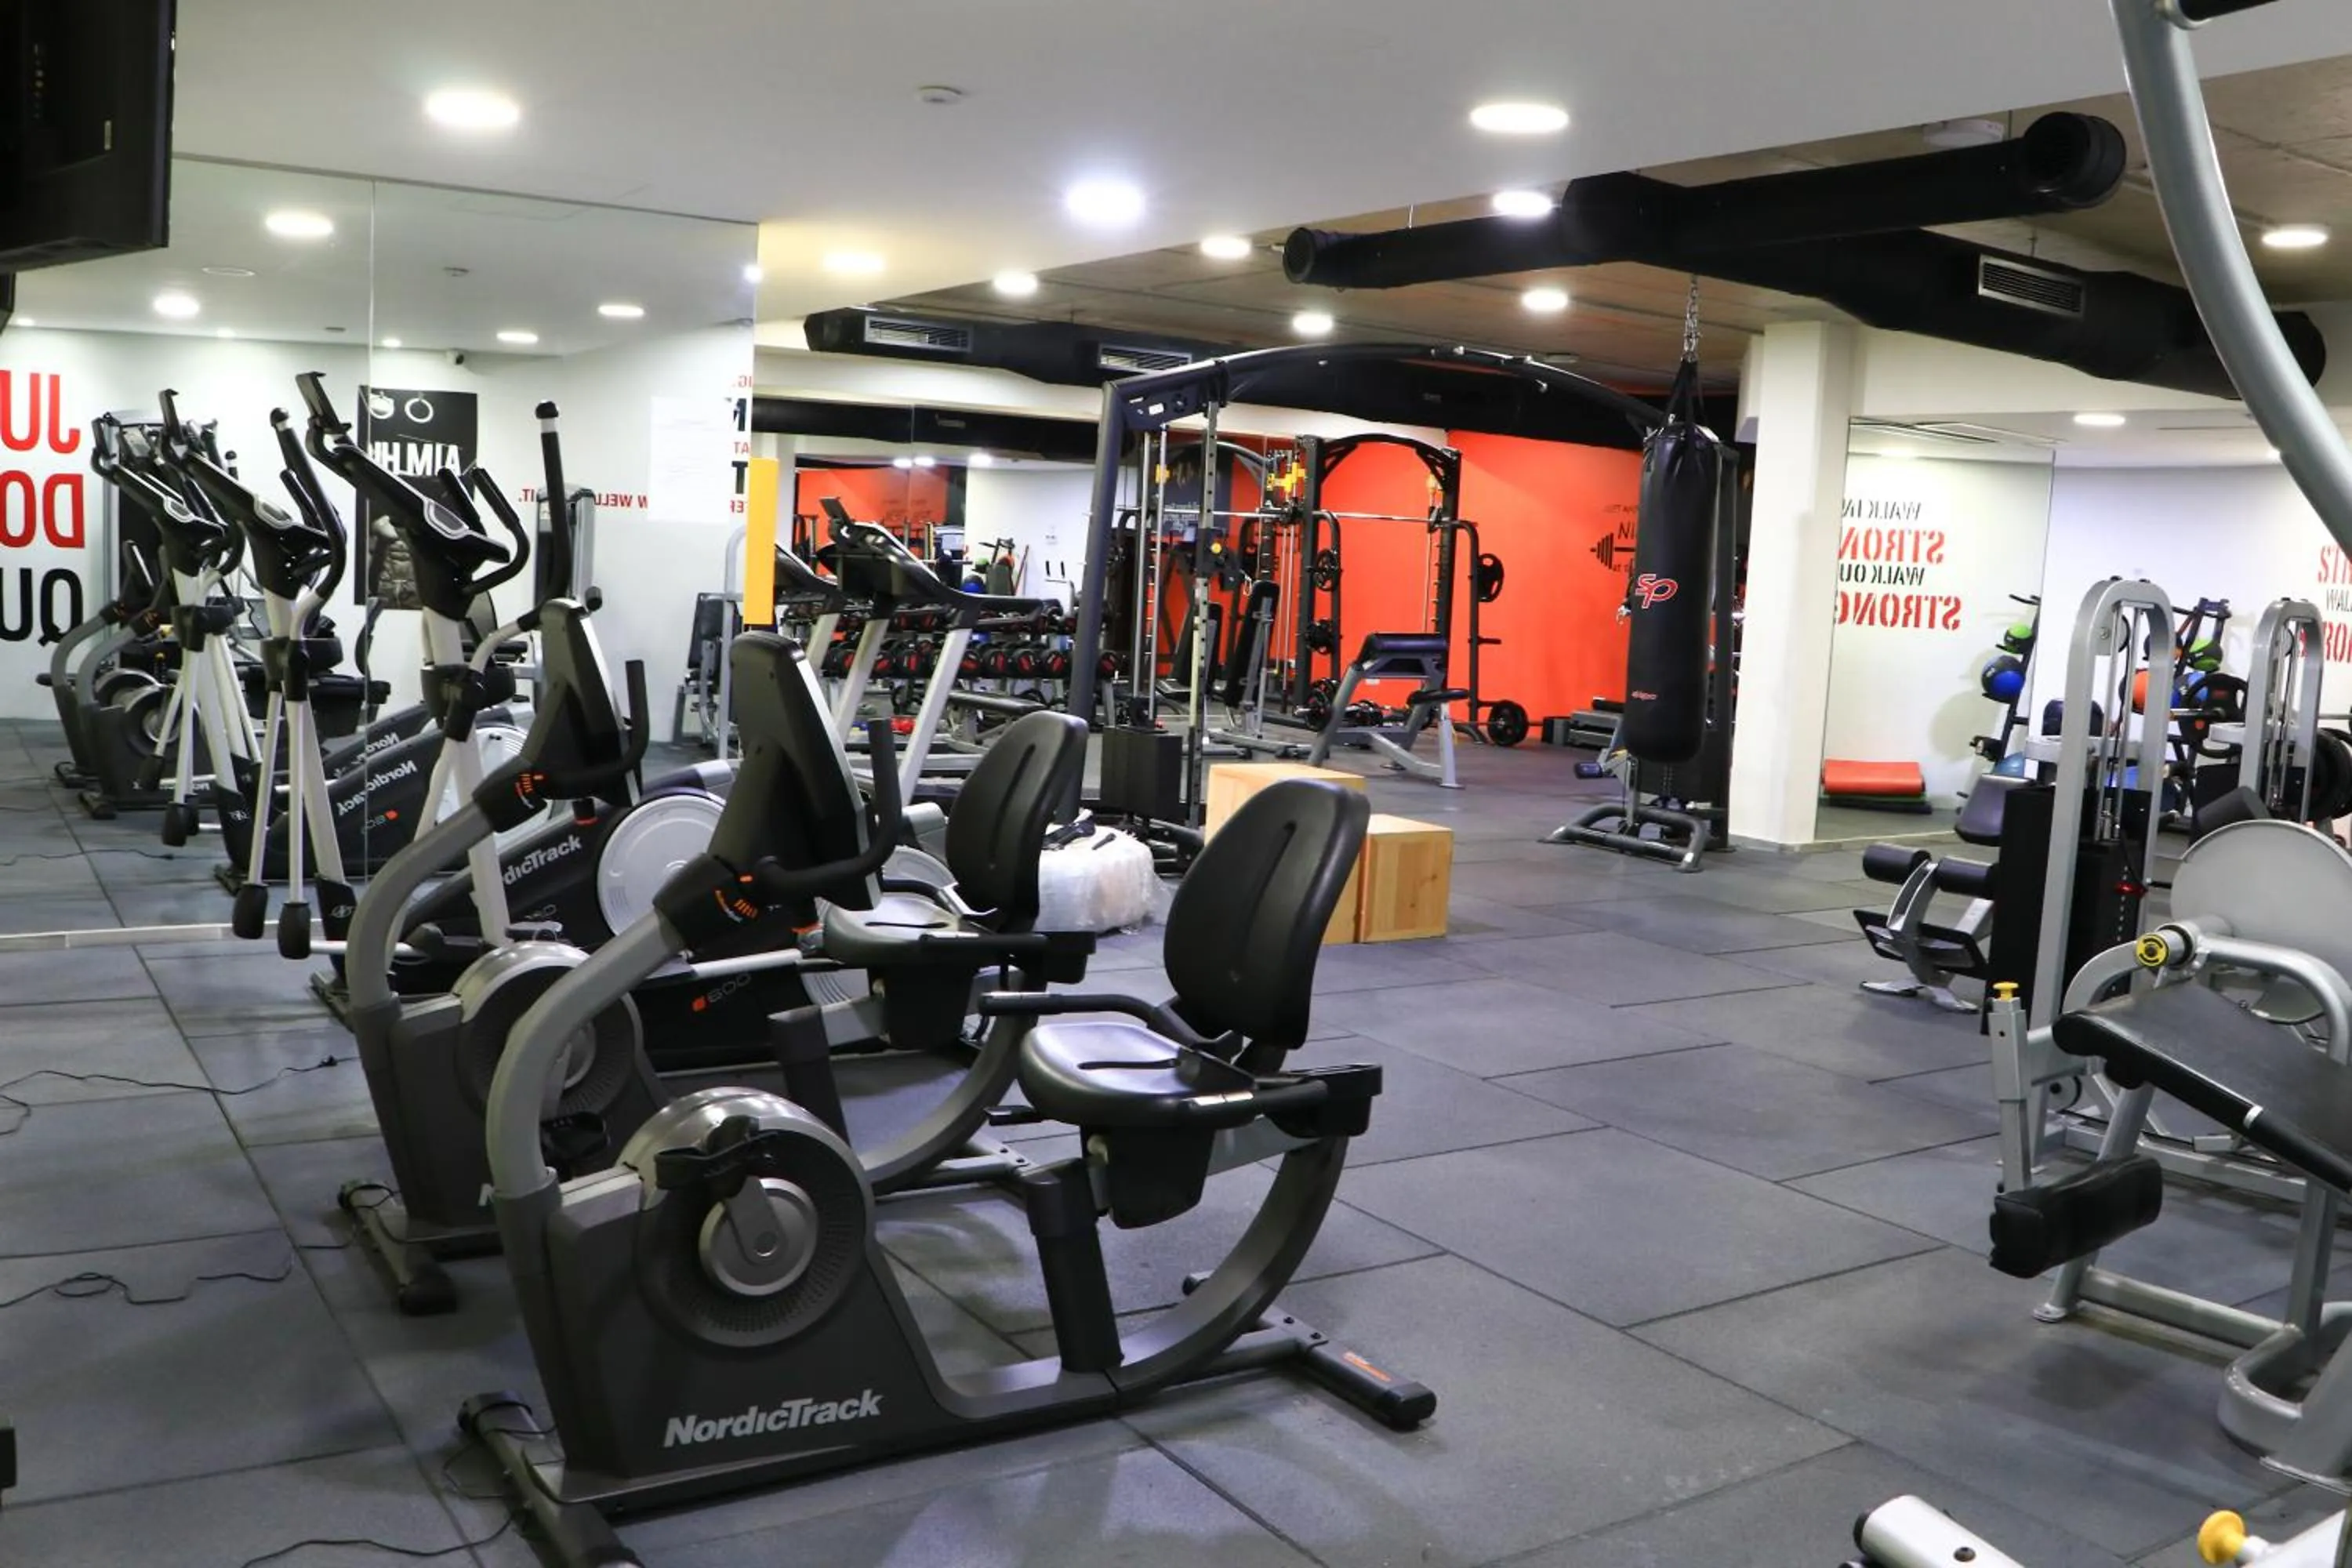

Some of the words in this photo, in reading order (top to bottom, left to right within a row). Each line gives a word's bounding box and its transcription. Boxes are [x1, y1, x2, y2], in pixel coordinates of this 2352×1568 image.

[2325, 589, 2352, 612] WAL
[503, 833, 583, 885] dicTrack
[663, 1388, 884, 1448] NordicTrack
